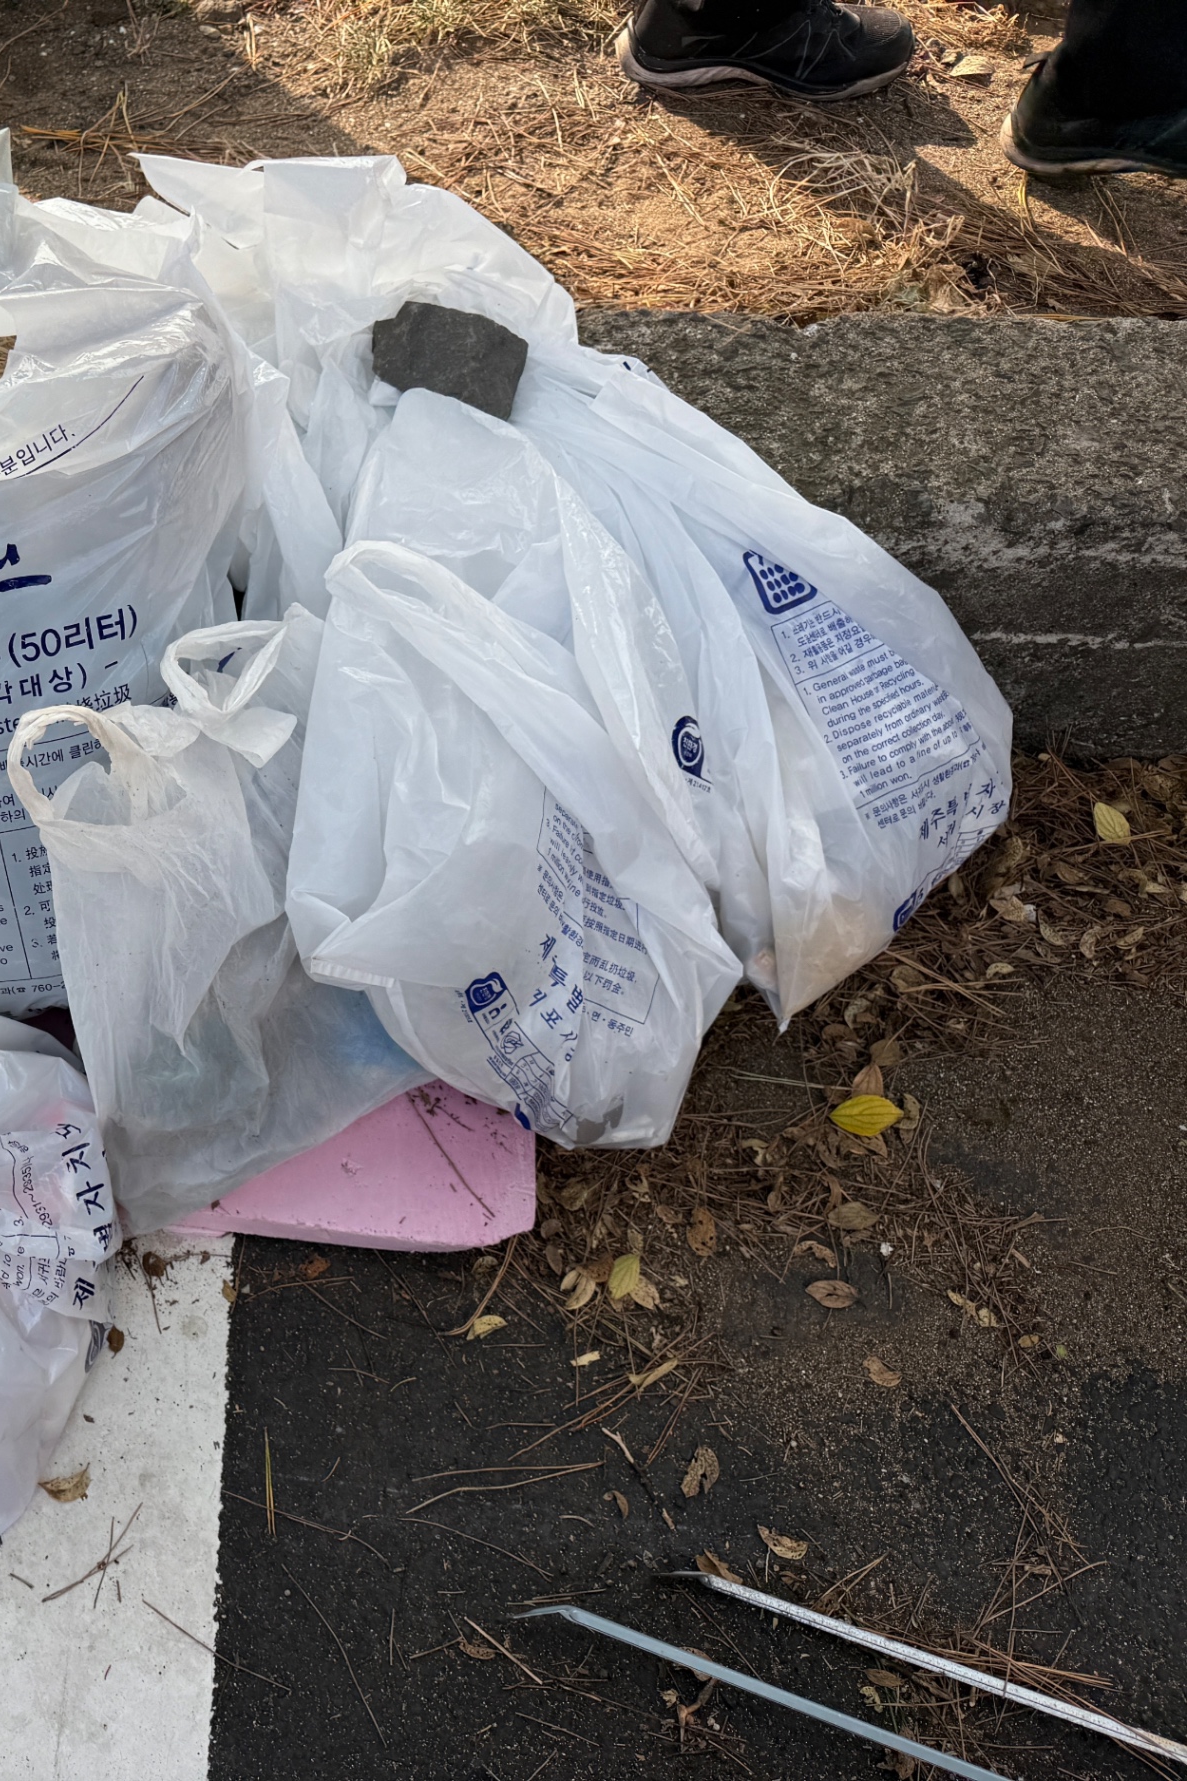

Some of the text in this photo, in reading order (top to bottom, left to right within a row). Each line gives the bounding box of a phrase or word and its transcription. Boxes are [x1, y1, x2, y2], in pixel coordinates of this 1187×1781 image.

[814, 607, 842, 625] 반드시
[790, 653, 801, 663] 2.
[794, 665, 806, 675] 3.
[807, 659, 819, 671] 위
[837, 642, 854, 656] 어길
[812, 671, 849, 692] General
[866, 651, 889, 669] must
[817, 664, 894, 704] in approved garbage
[821, 668, 916, 716] Clean House Recycling
[827, 679, 925, 729] during the specified hours.
[831, 719, 873, 740] Dispose
[873, 698, 913, 724] recyclable
[836, 728, 883, 752] separately
[884, 718, 905, 732] from
[903, 702, 932, 723] ordinary
[841, 754, 853, 764] on
[853, 748, 870, 759] the
[870, 733, 901, 752] correct
[901, 717, 932, 739] collection
[931, 711, 946, 722] day.
[847, 759, 876, 775] Failure
[877, 754, 888, 763] to
[889, 741, 917, 759] comply
[917, 732, 932, 745] with
[930, 726, 942, 737] the
[853, 774, 868, 787] will
[869, 763, 893, 780] lead
[895, 760, 906, 770] to
[909, 755, 916, 764] a
[933, 739, 941, 751] of
[942, 735, 952, 746] up
[889, 772, 913, 785] won.
[899, 805, 917, 819] 문의
[23, 905, 35, 916] 2.
